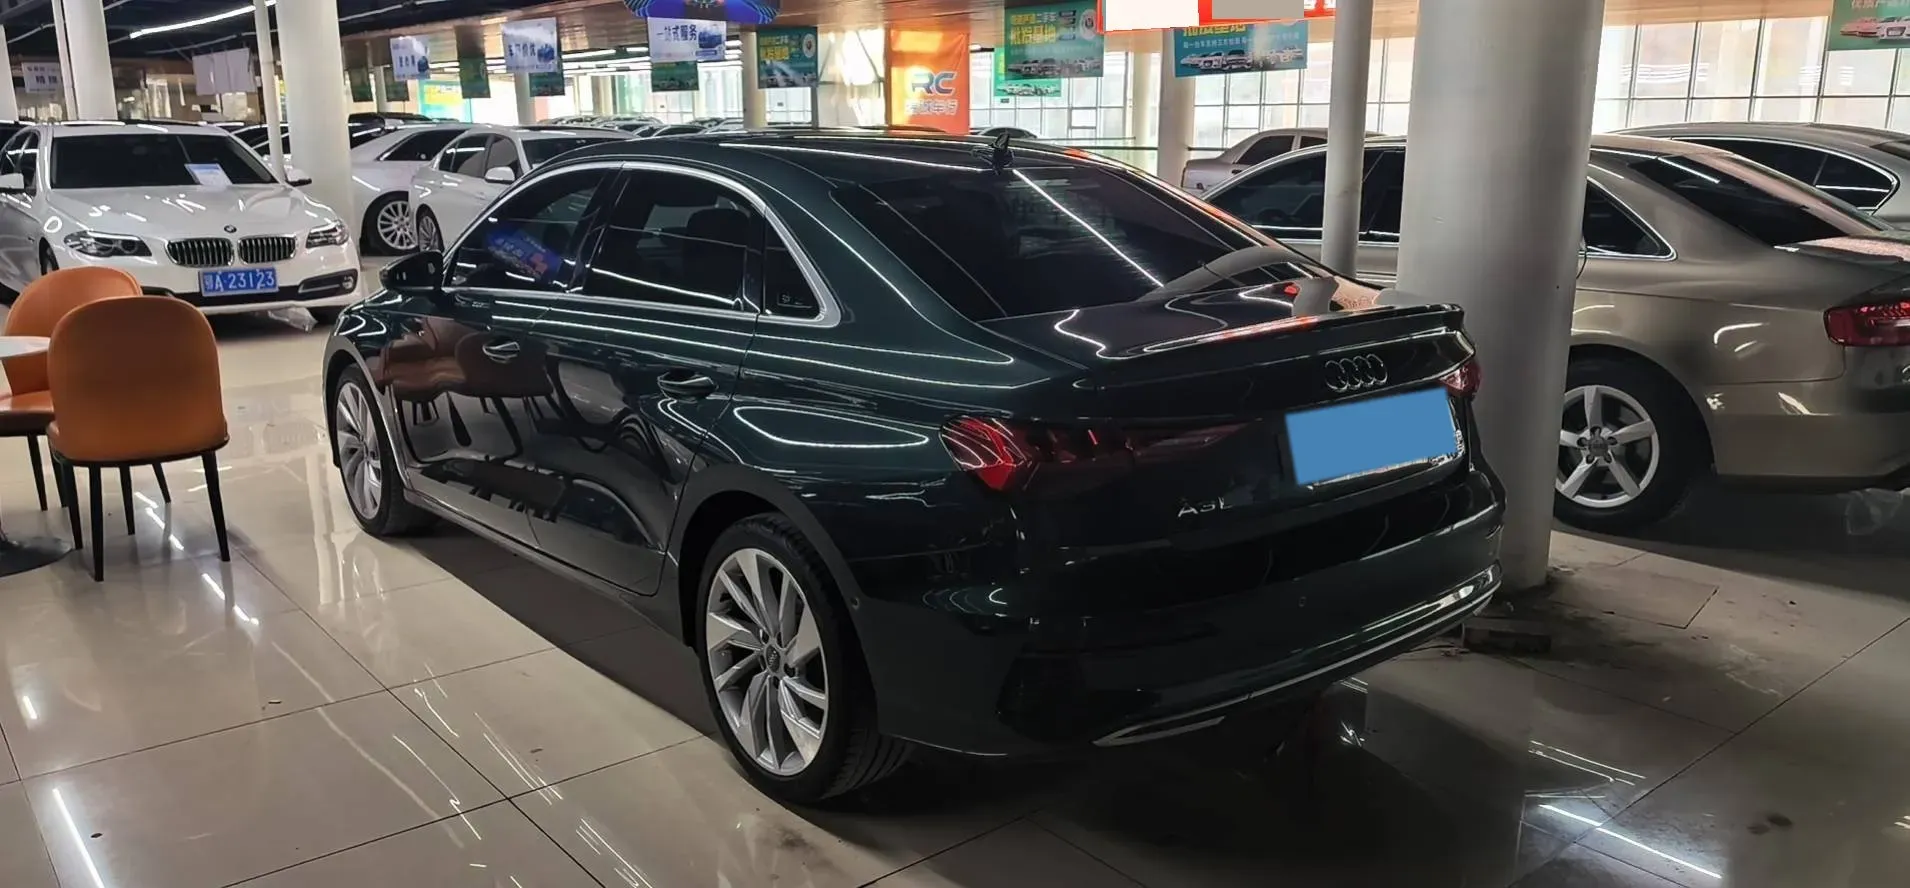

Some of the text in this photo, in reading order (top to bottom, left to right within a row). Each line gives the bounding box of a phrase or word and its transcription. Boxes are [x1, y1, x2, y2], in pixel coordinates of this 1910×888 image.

[656, 24, 697, 41] 一站式服务
[911, 72, 956, 94] RC
